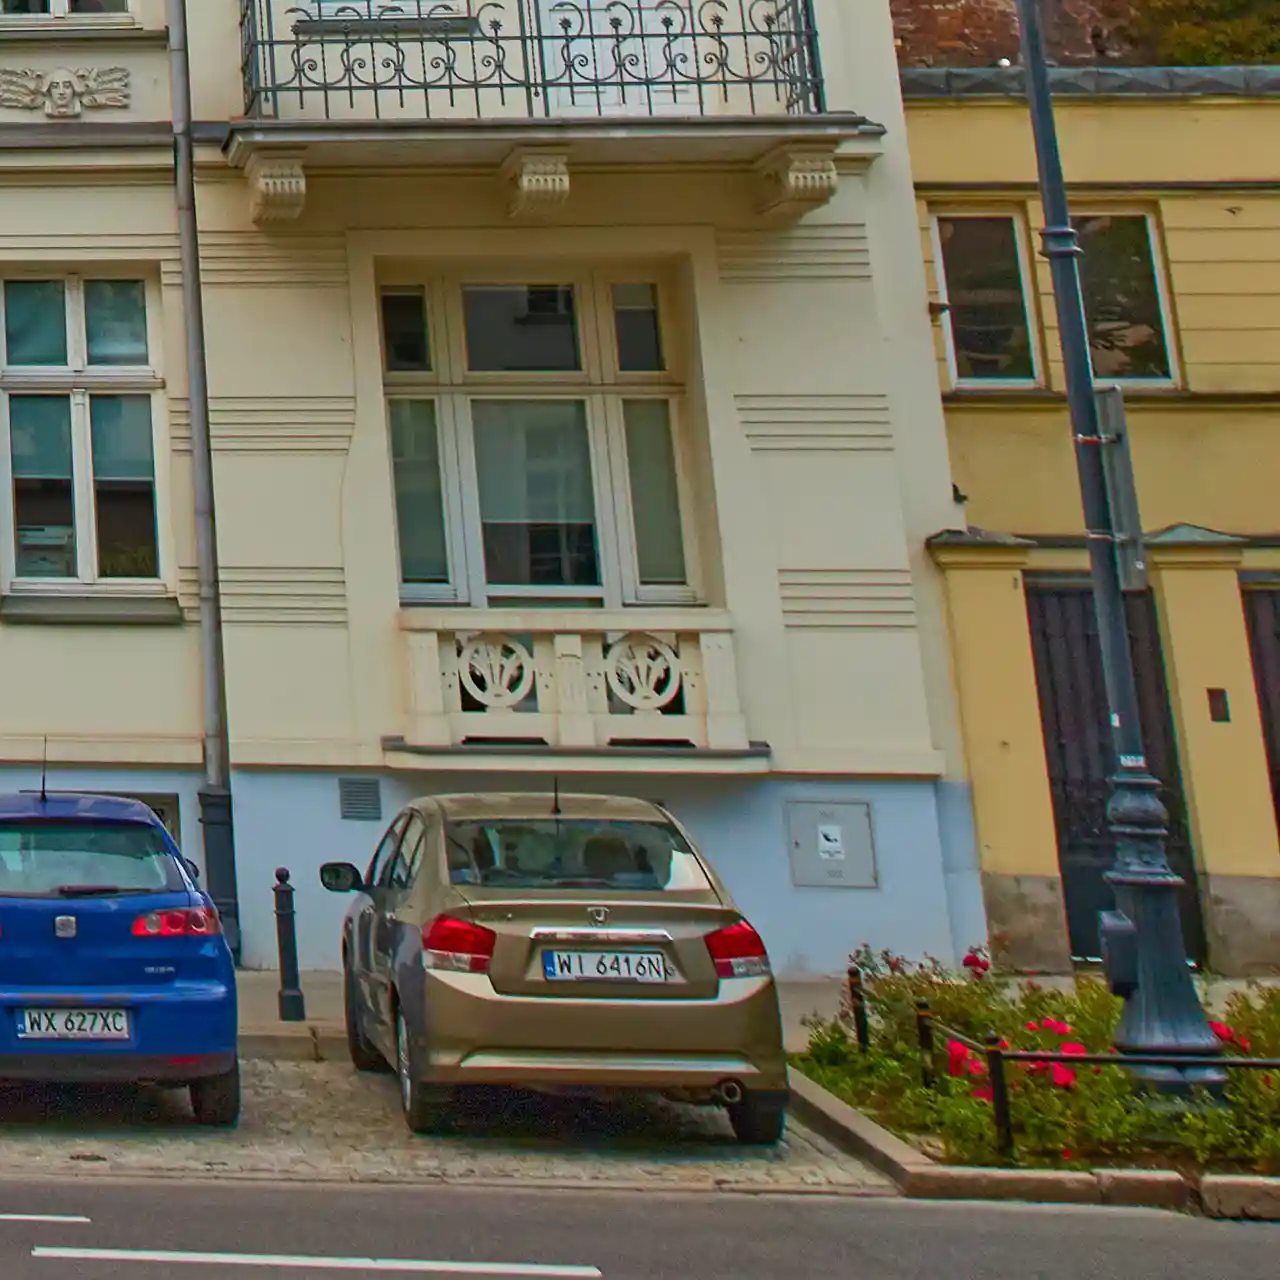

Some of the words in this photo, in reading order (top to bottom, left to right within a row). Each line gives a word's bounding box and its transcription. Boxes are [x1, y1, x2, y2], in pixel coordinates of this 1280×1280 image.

[557, 953, 584, 976] WI
[596, 953, 663, 978] 6416N
[27, 1011, 57, 1032] WX
[64, 1012, 124, 1033] 627XC
